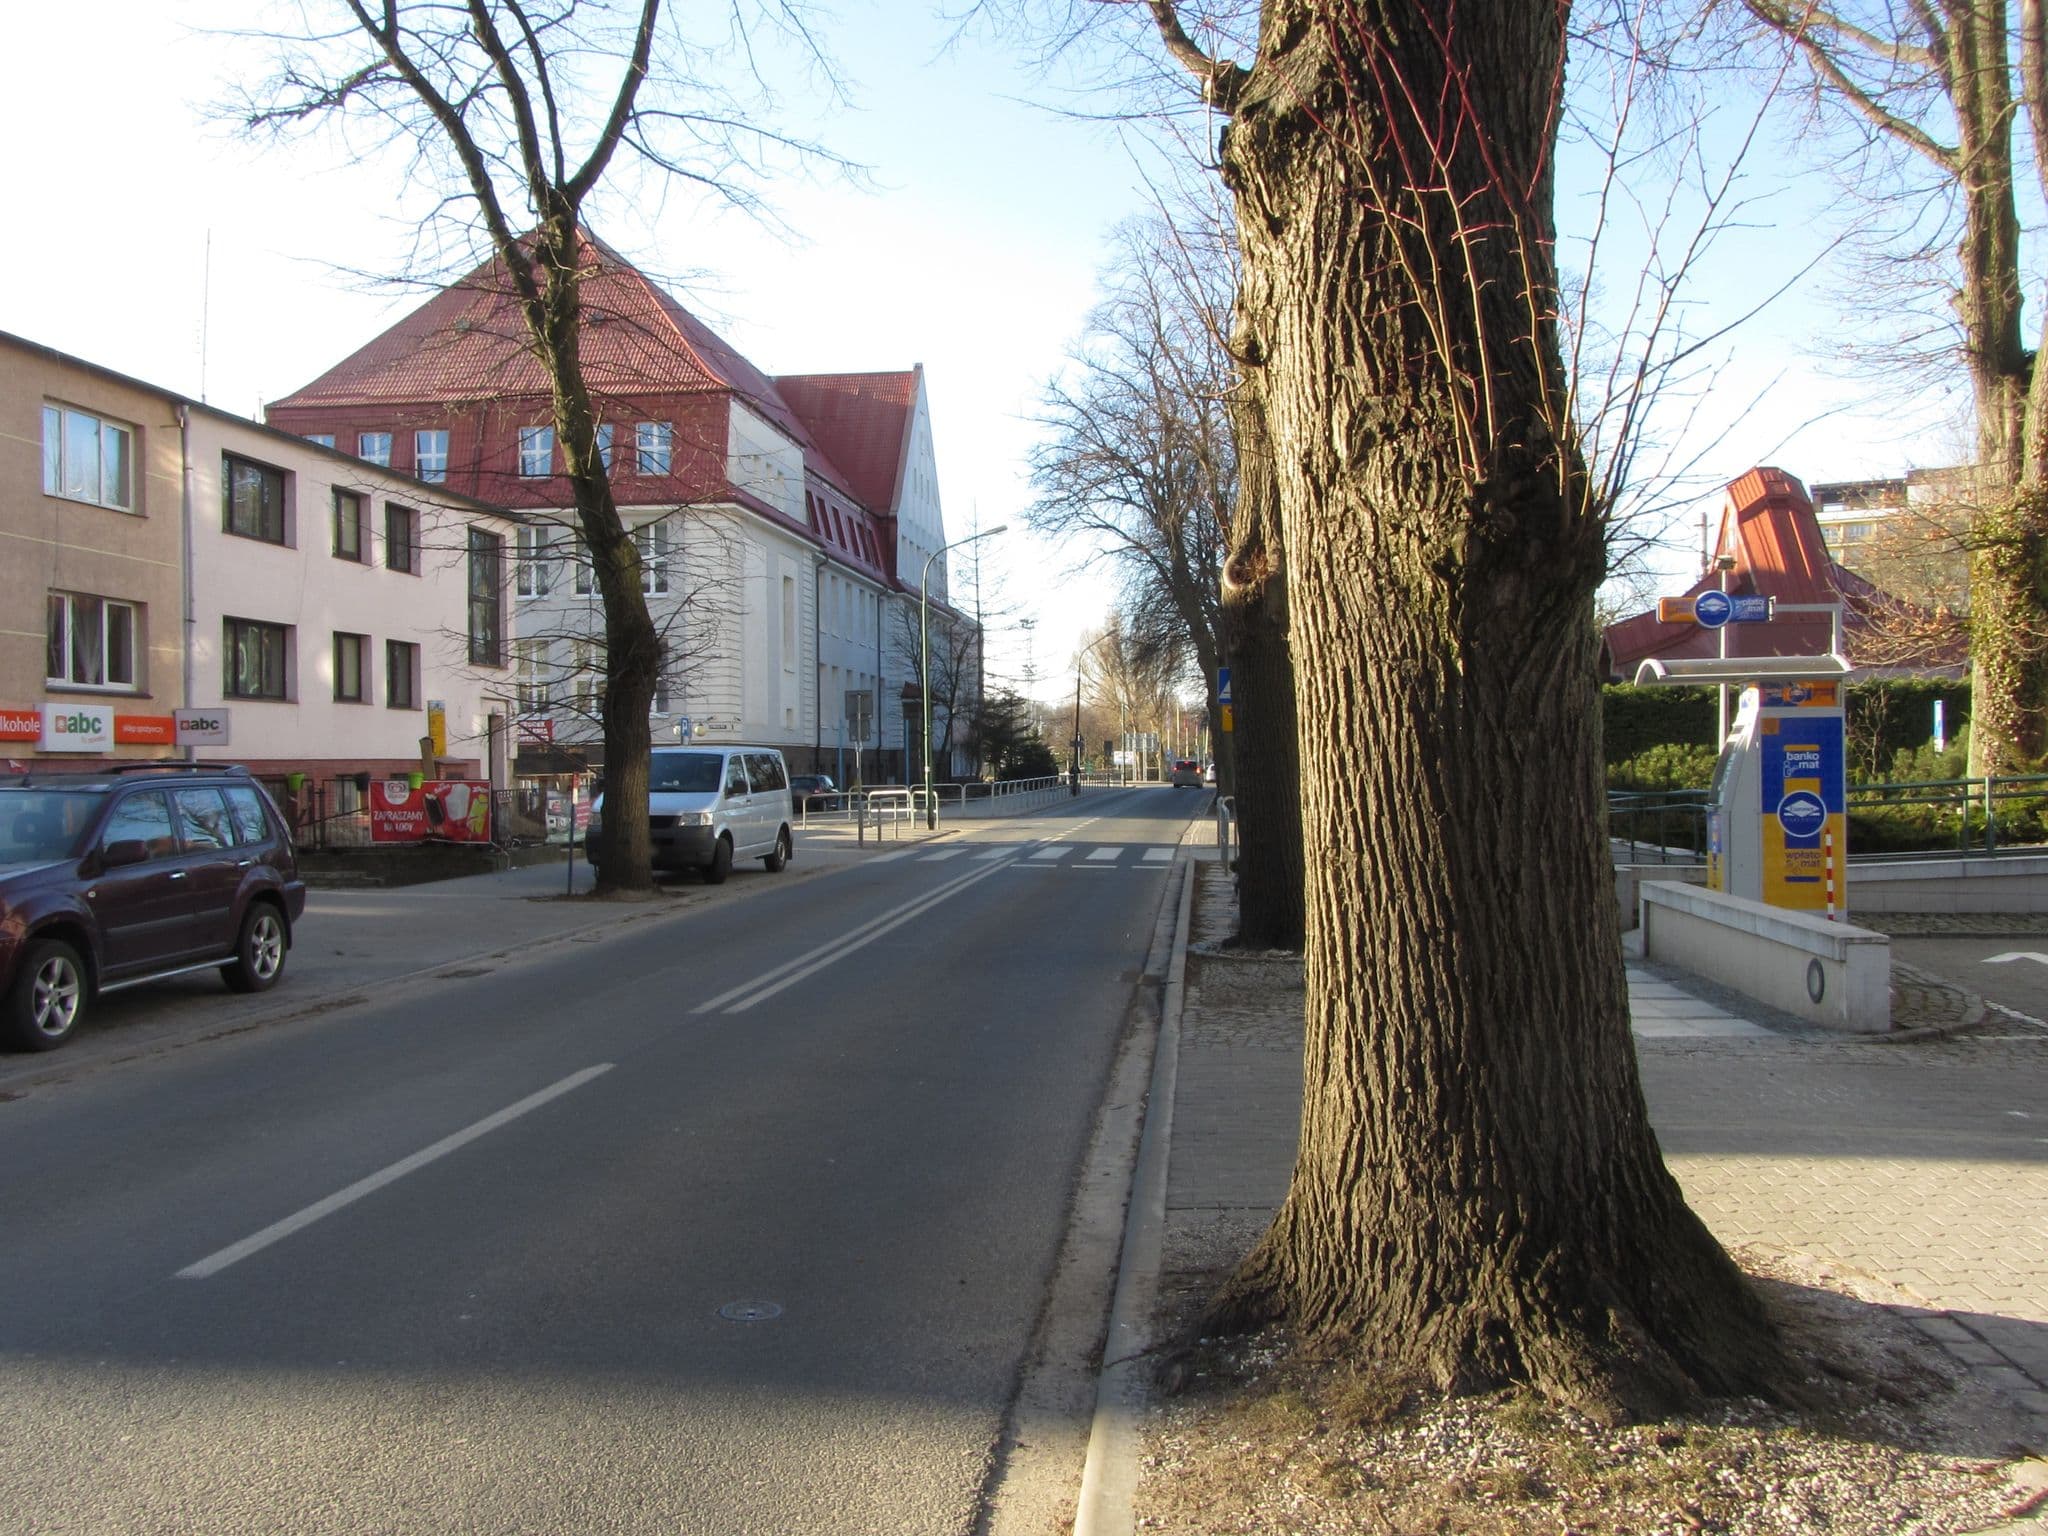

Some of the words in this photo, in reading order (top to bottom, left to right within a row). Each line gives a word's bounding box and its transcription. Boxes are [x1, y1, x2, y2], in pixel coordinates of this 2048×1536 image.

[68, 712, 102, 734] abc
[190, 717, 219, 730] abc
[1786, 752, 1819, 760] banko
[1799, 761, 1819, 769] mat
